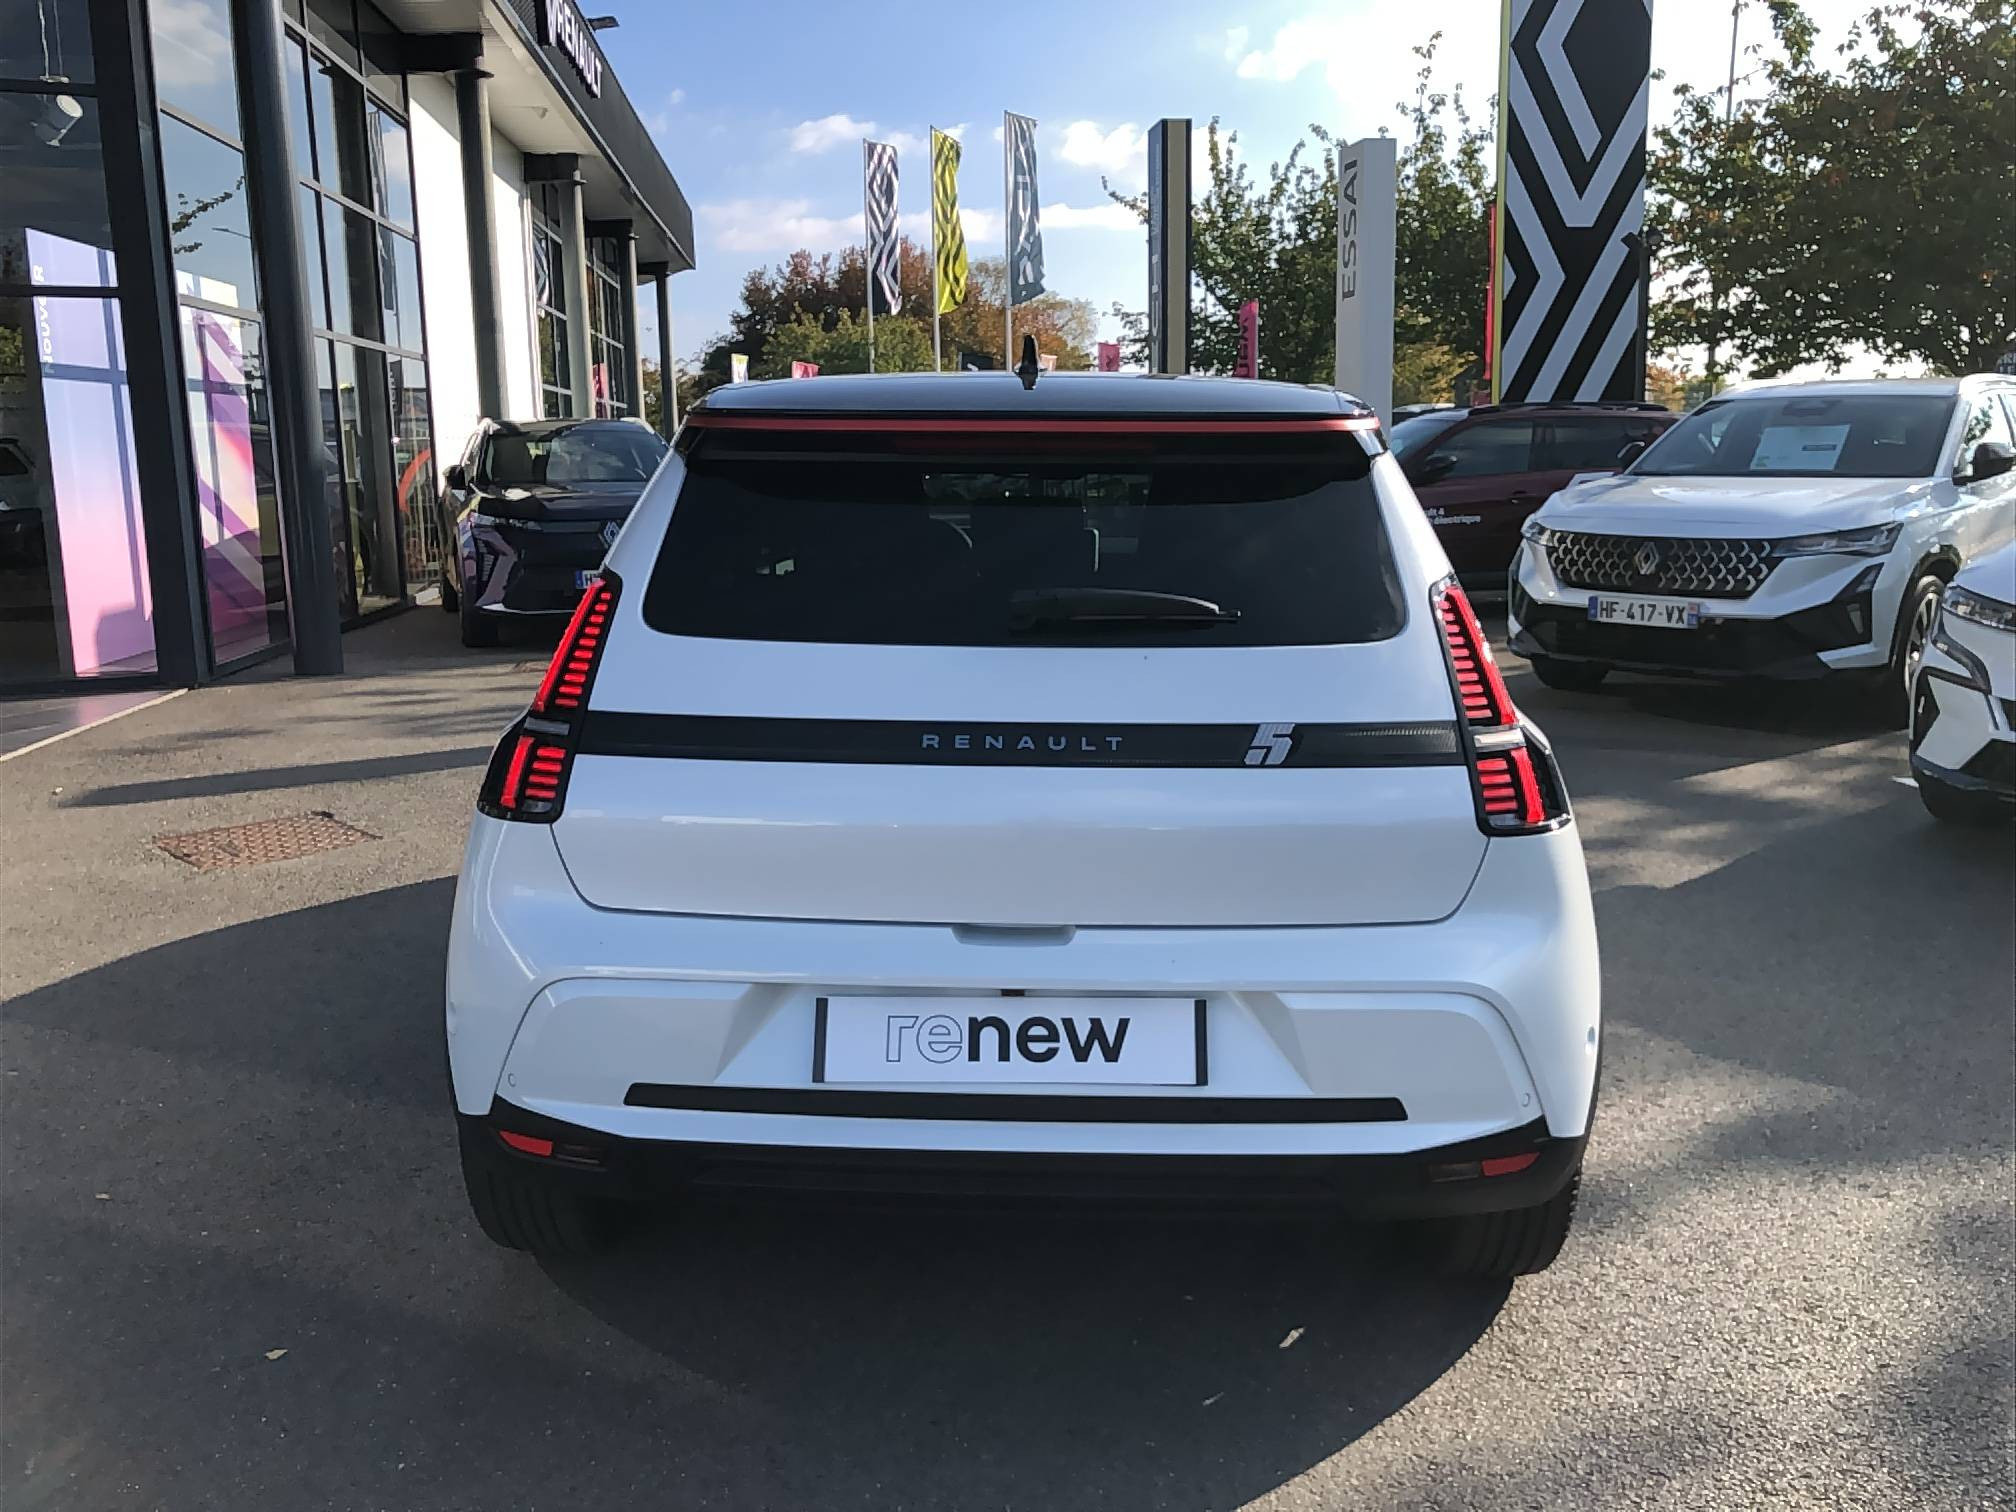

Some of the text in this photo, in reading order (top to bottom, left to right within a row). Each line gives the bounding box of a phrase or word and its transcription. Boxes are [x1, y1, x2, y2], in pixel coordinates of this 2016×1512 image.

[557, 0, 602, 99] RENAULT
[1342, 158, 1358, 301] ESSAI
[1600, 600, 1686, 625] HF-417-VX
[921, 722, 1295, 766] RENAULT 5
[885, 1014, 1131, 1064] renew
